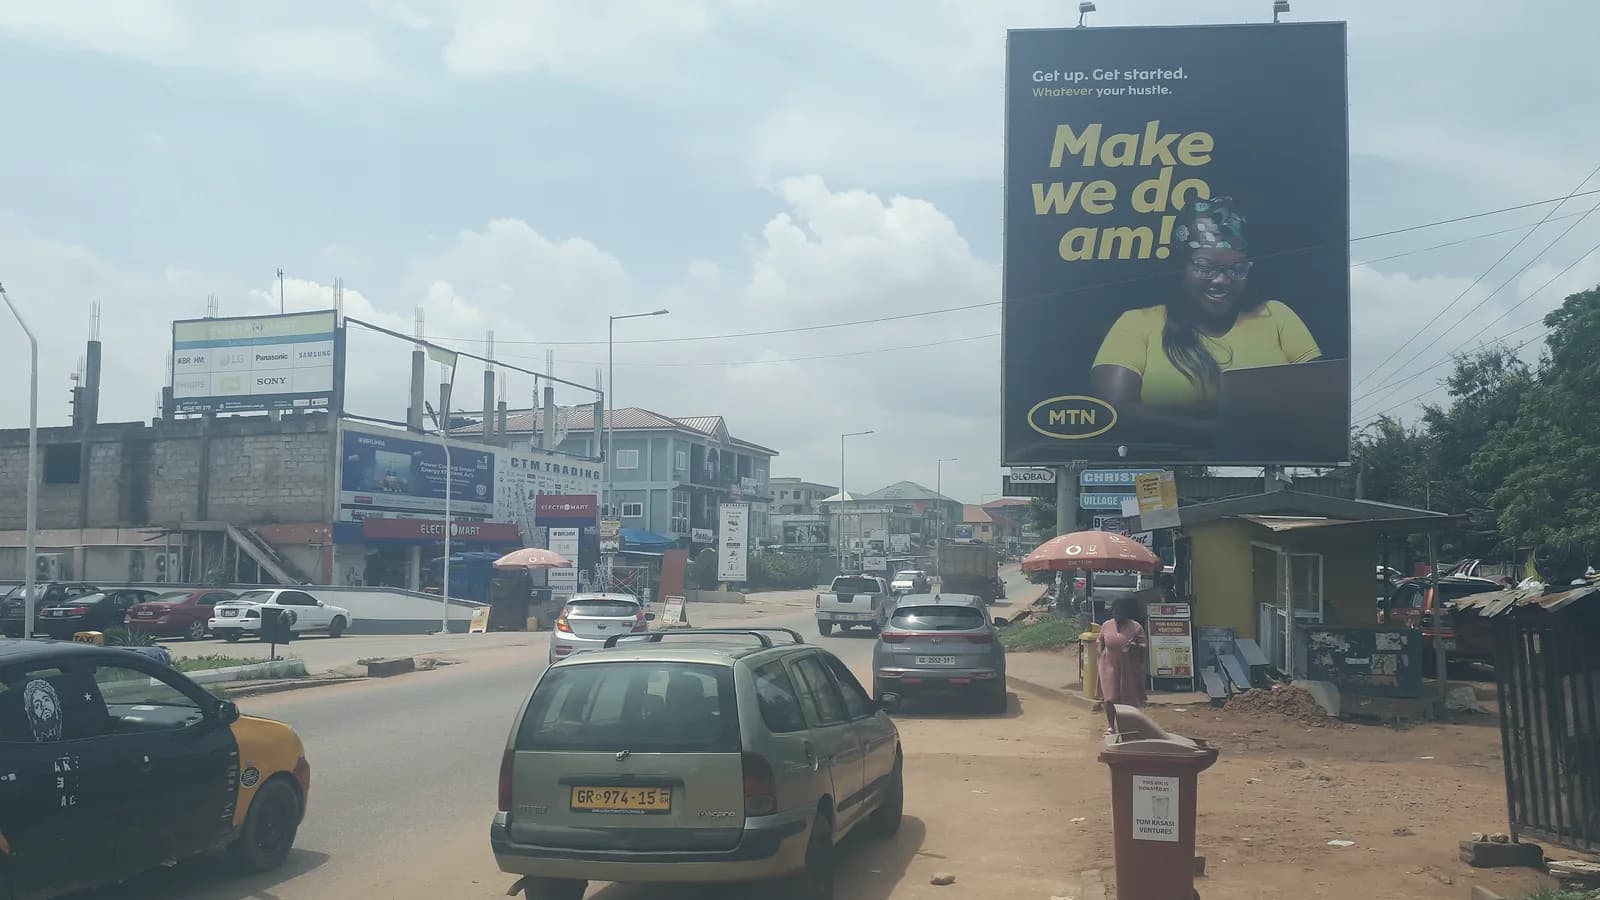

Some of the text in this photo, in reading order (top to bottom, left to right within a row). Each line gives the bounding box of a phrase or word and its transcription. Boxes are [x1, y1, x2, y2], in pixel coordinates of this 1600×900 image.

[1032, 67, 1188, 85] Get up. Get started.
[1032, 85, 1172, 98] Whatever your hustle.
[1049, 120, 1215, 168] Make
[1031, 166, 1211, 215] we do
[1059, 215, 1177, 262] am!
[255, 353, 289, 362] Panasonic
[298, 350, 331, 359] SAMSUNG
[256, 377, 287, 386] SONY
[1050, 409, 1096, 425] MTN
[511, 457, 600, 480] CTM TRADING
[1011, 473, 1047, 481] GLOBAL
[1084, 496, 1118, 505] VILLAGE
[420, 523, 481, 536] ELECTOMART
[577, 790, 594, 804] GR
[603, 790, 656, 805] 974-15
